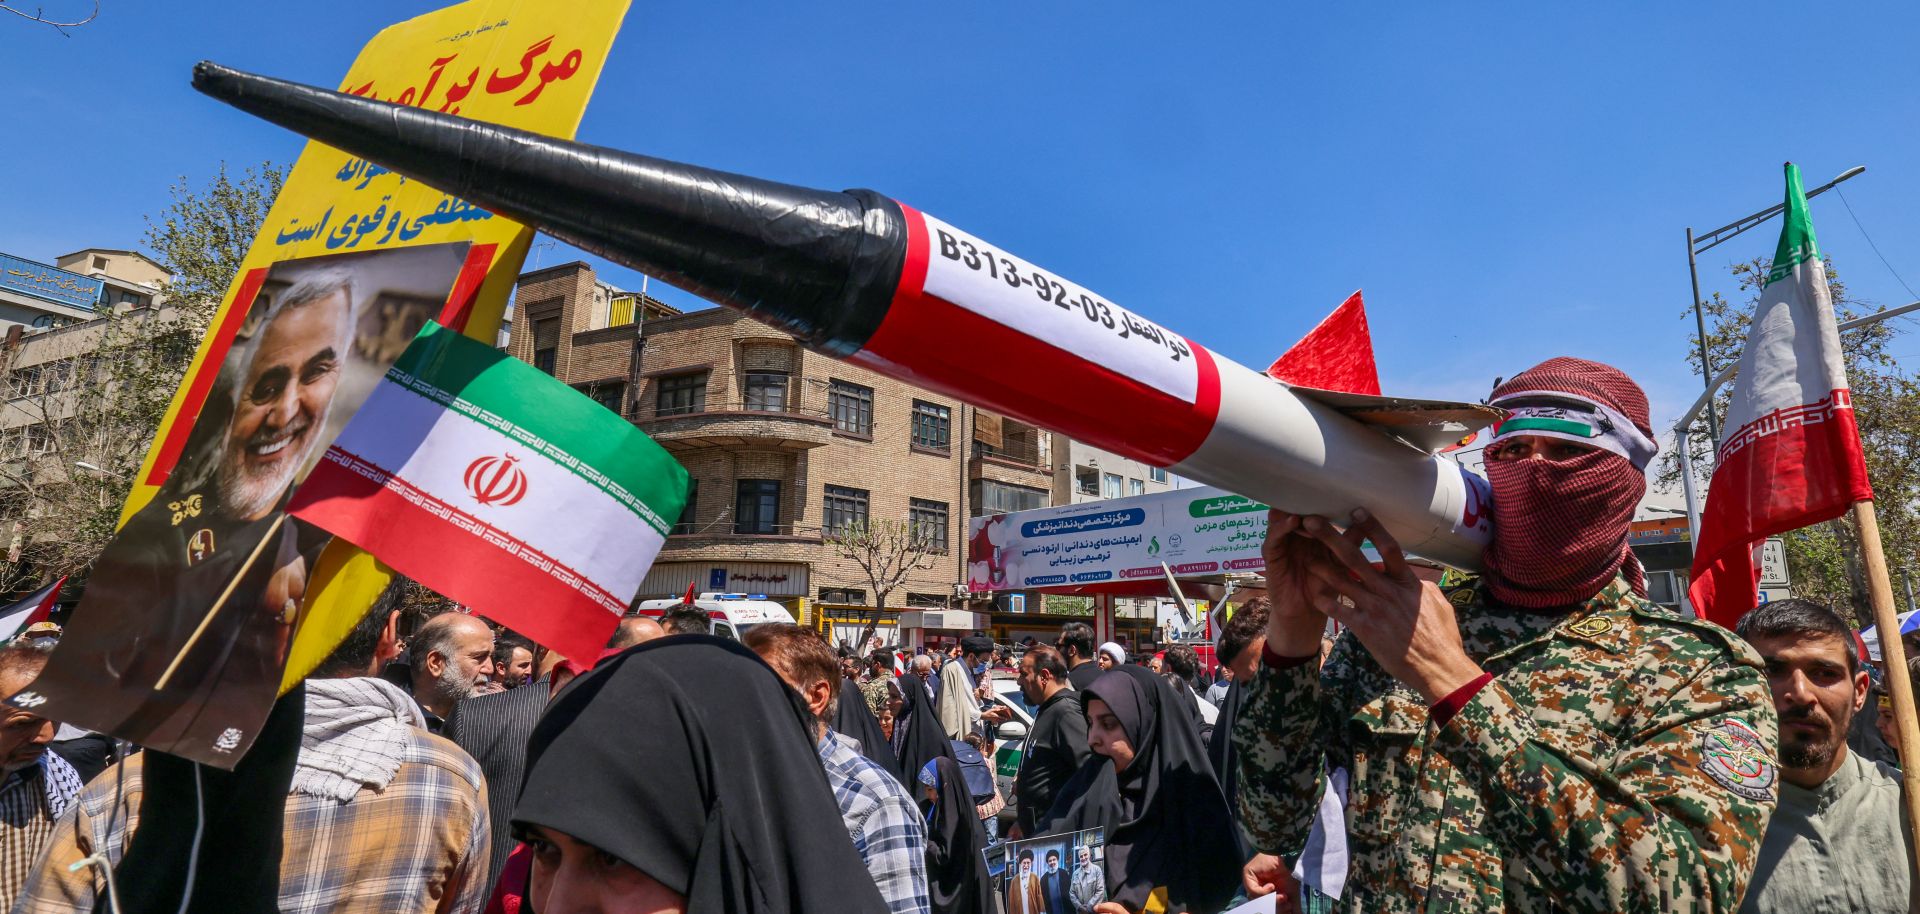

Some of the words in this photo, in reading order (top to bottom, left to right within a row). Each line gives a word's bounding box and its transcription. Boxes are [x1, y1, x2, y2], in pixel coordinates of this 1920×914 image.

[485, 34, 582, 107] مرگ
[438, 66, 480, 116] بر
[275, 204, 335, 246] است
[326, 194, 392, 250] قوی
[376, 210, 401, 245] و
[935, 227, 1116, 331] B313-92-03
[1204, 500, 1227, 514] زخم
[1228, 499, 1257, 512] رمیم
[1078, 515, 1112, 529] تخصصی
[1111, 512, 1131, 525] مرکز
[1033, 520, 1079, 535] دندانپزشکی
[1194, 522, 1217, 533] مزمن
[1227, 530, 1257, 542] عروقی
[1022, 544, 1060, 557] ارتودنسی
[1065, 540, 1094, 553] دندانی
[1049, 554, 1077, 566] زیبایی
[1078, 550, 1111, 564] ترمیمی
